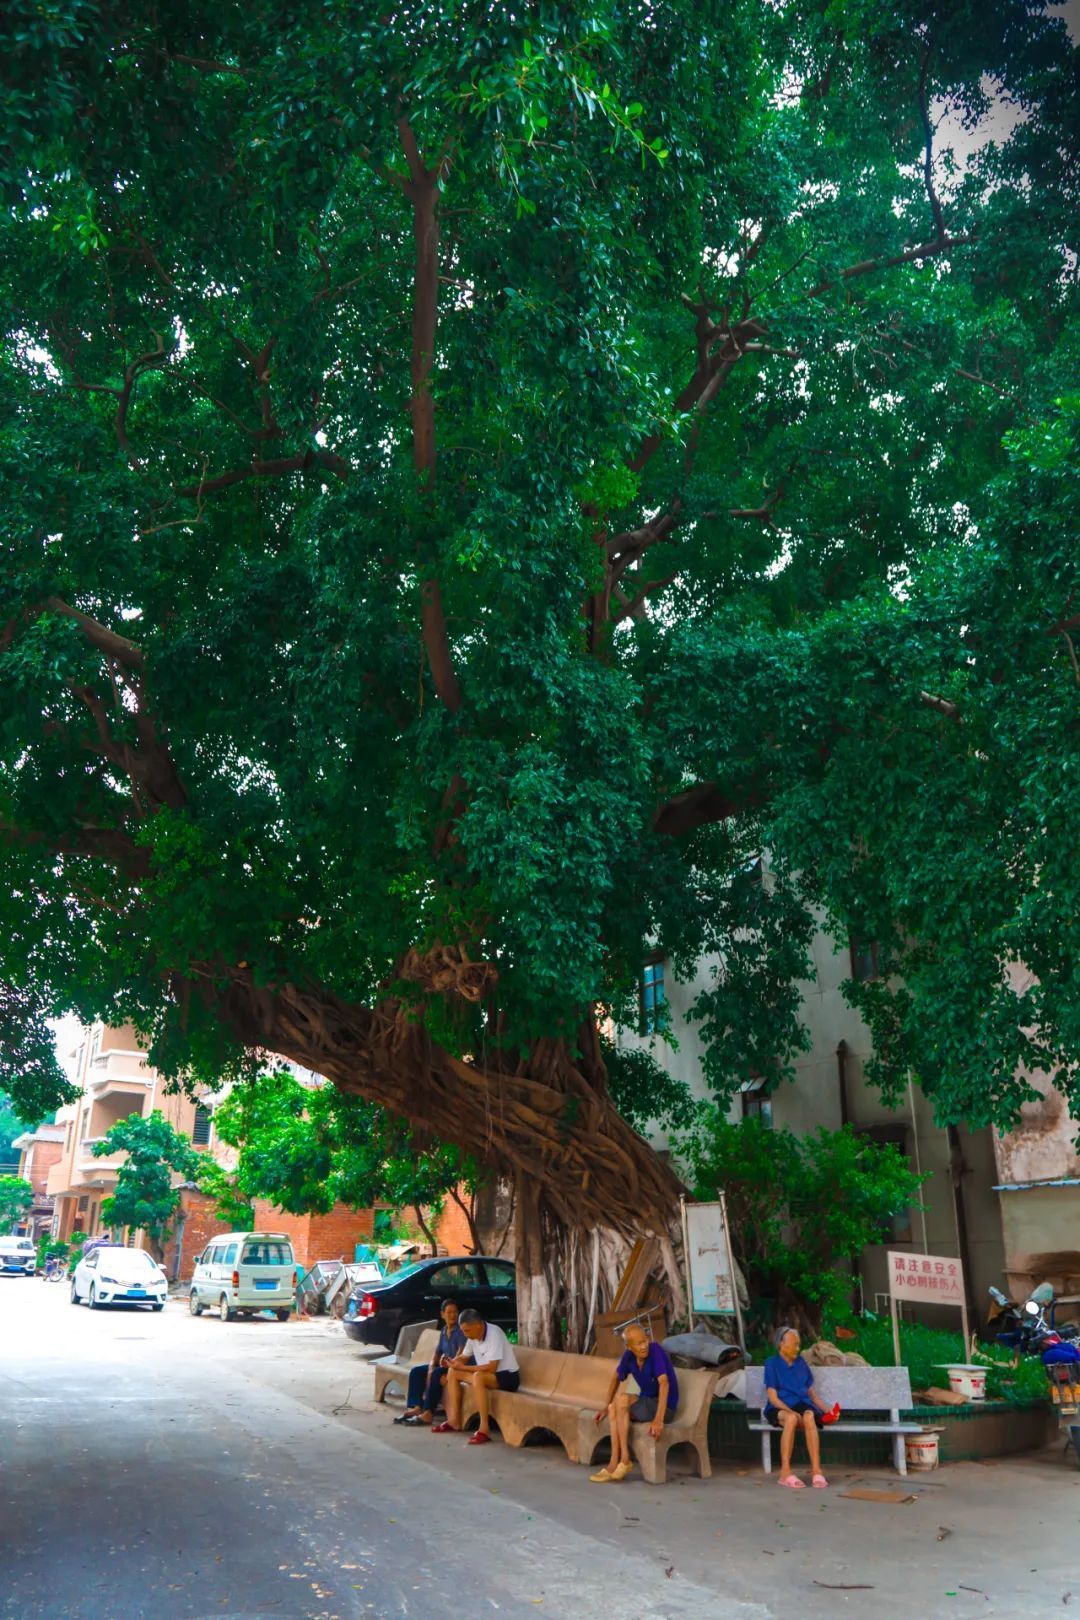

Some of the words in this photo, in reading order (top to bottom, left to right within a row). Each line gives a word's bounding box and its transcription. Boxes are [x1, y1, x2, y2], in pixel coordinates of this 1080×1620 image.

[894, 1257, 957, 1276] 请注意安全
